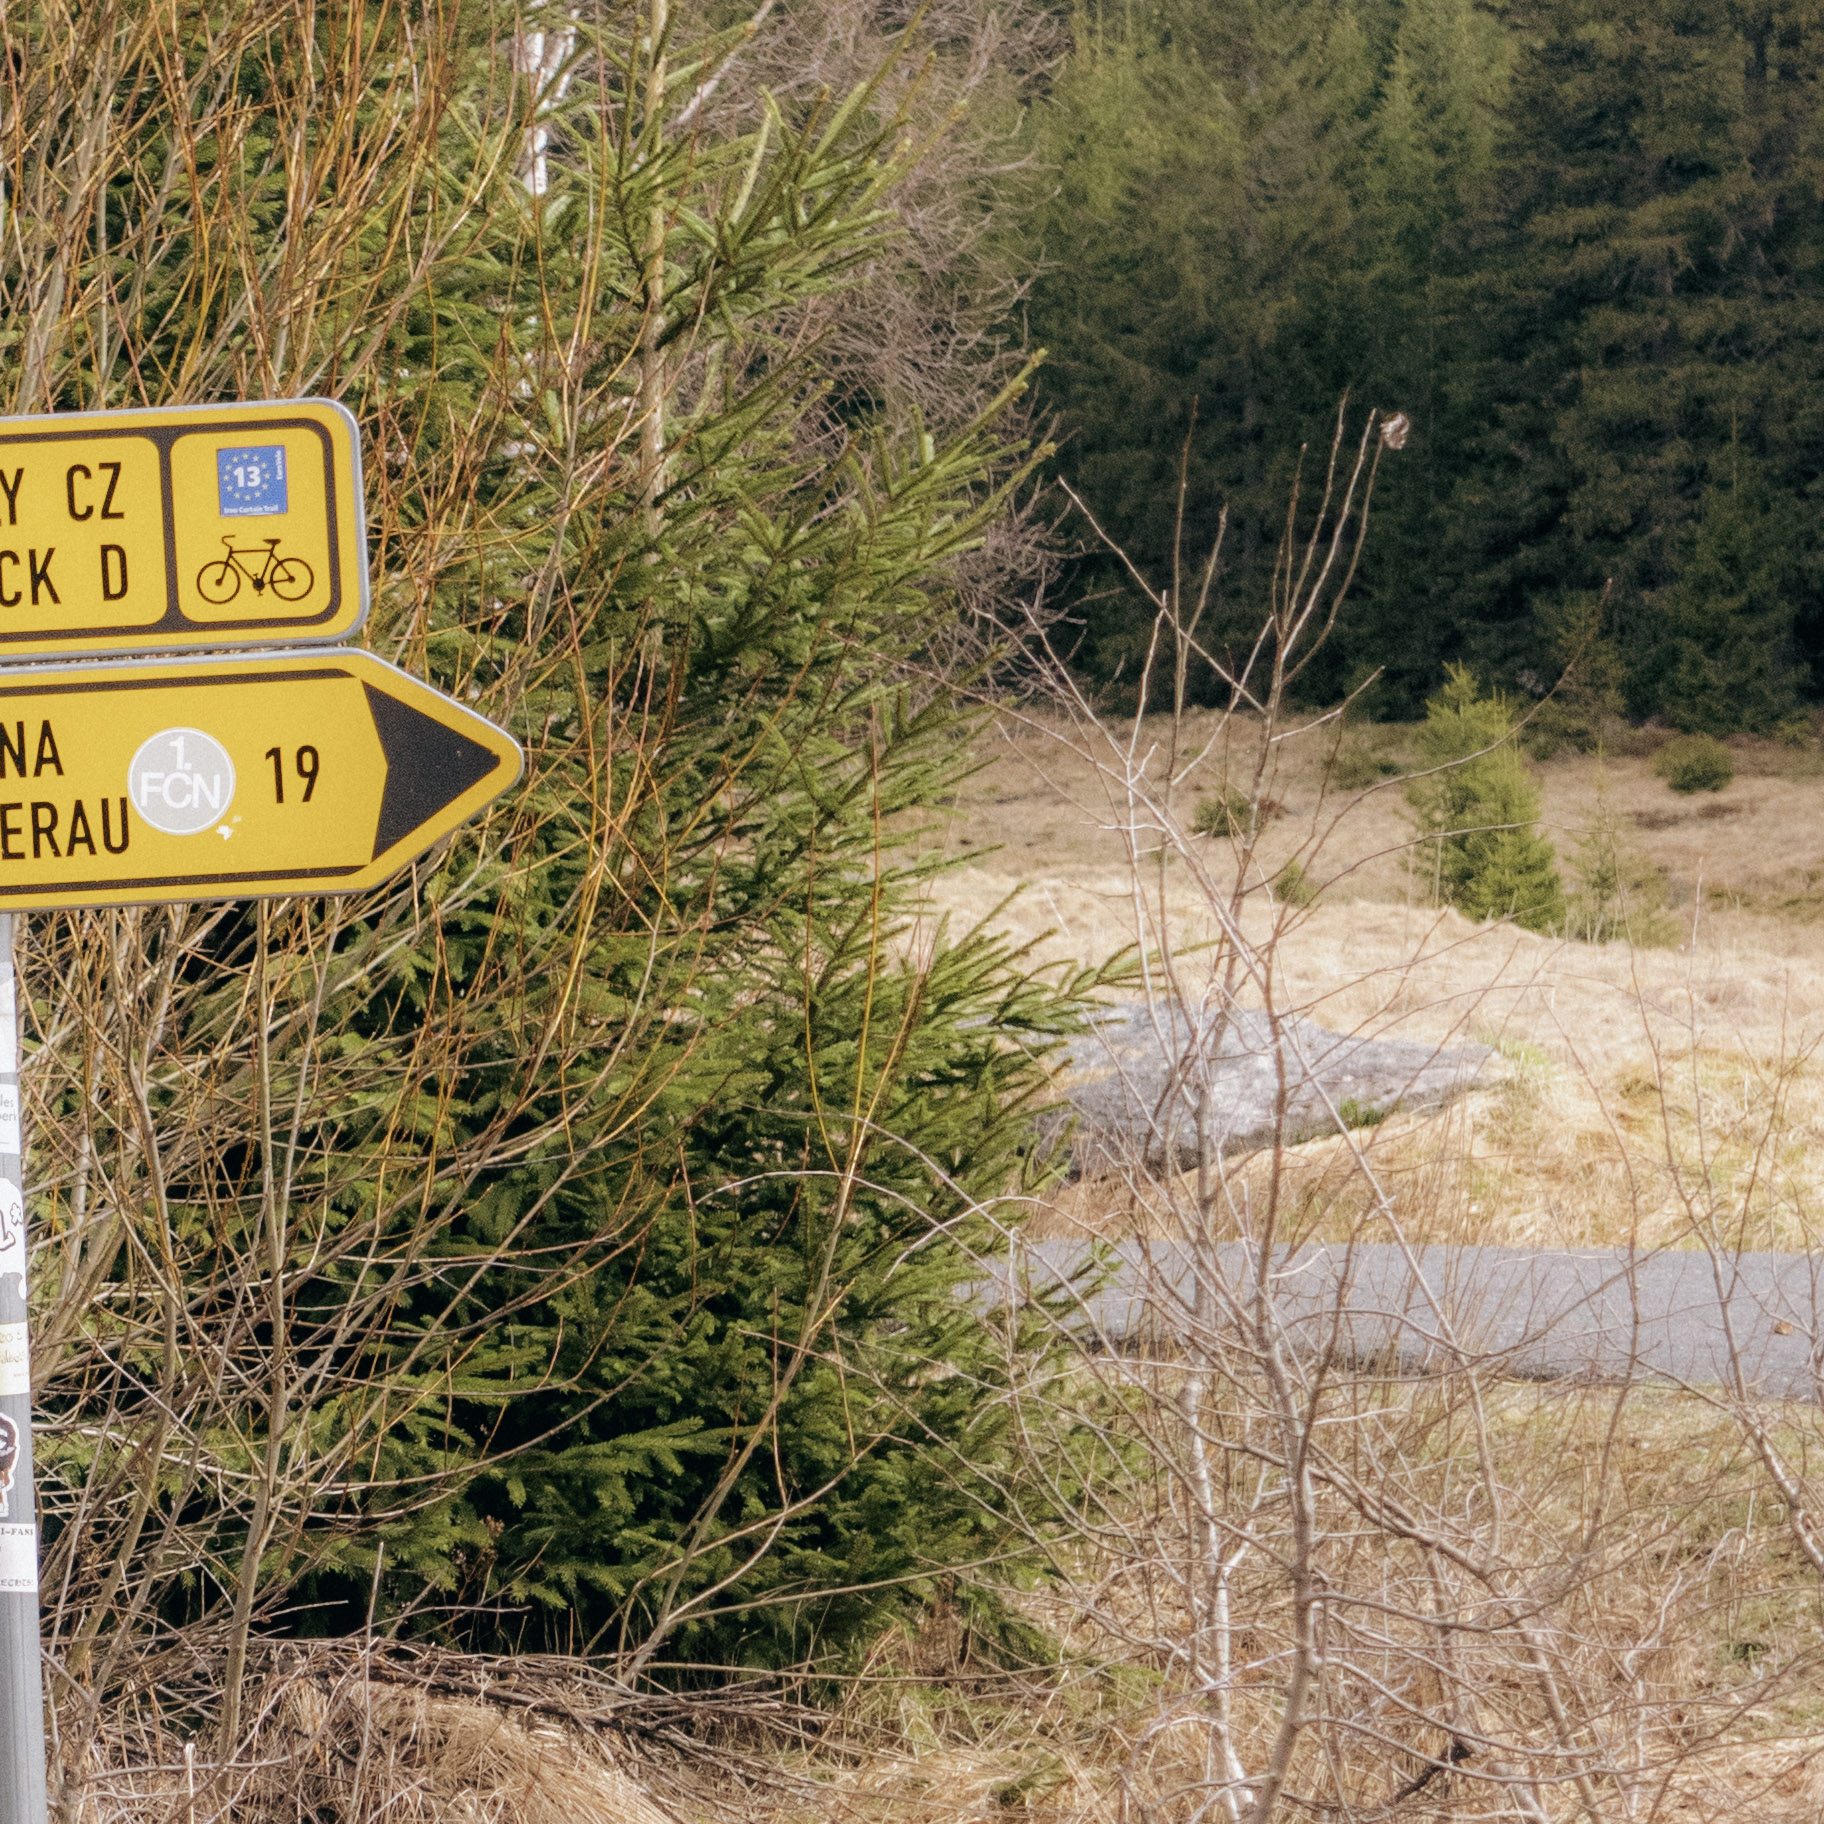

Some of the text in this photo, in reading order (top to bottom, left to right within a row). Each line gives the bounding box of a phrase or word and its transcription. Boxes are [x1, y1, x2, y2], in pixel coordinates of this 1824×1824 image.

[66, 461, 126, 522] CZ
[233, 465, 261, 488] 13
[100, 543, 129, 602] D
[169, 735, 192, 770] 1.
[264, 744, 320, 804] 19
[140, 771, 220, 809] FCN
